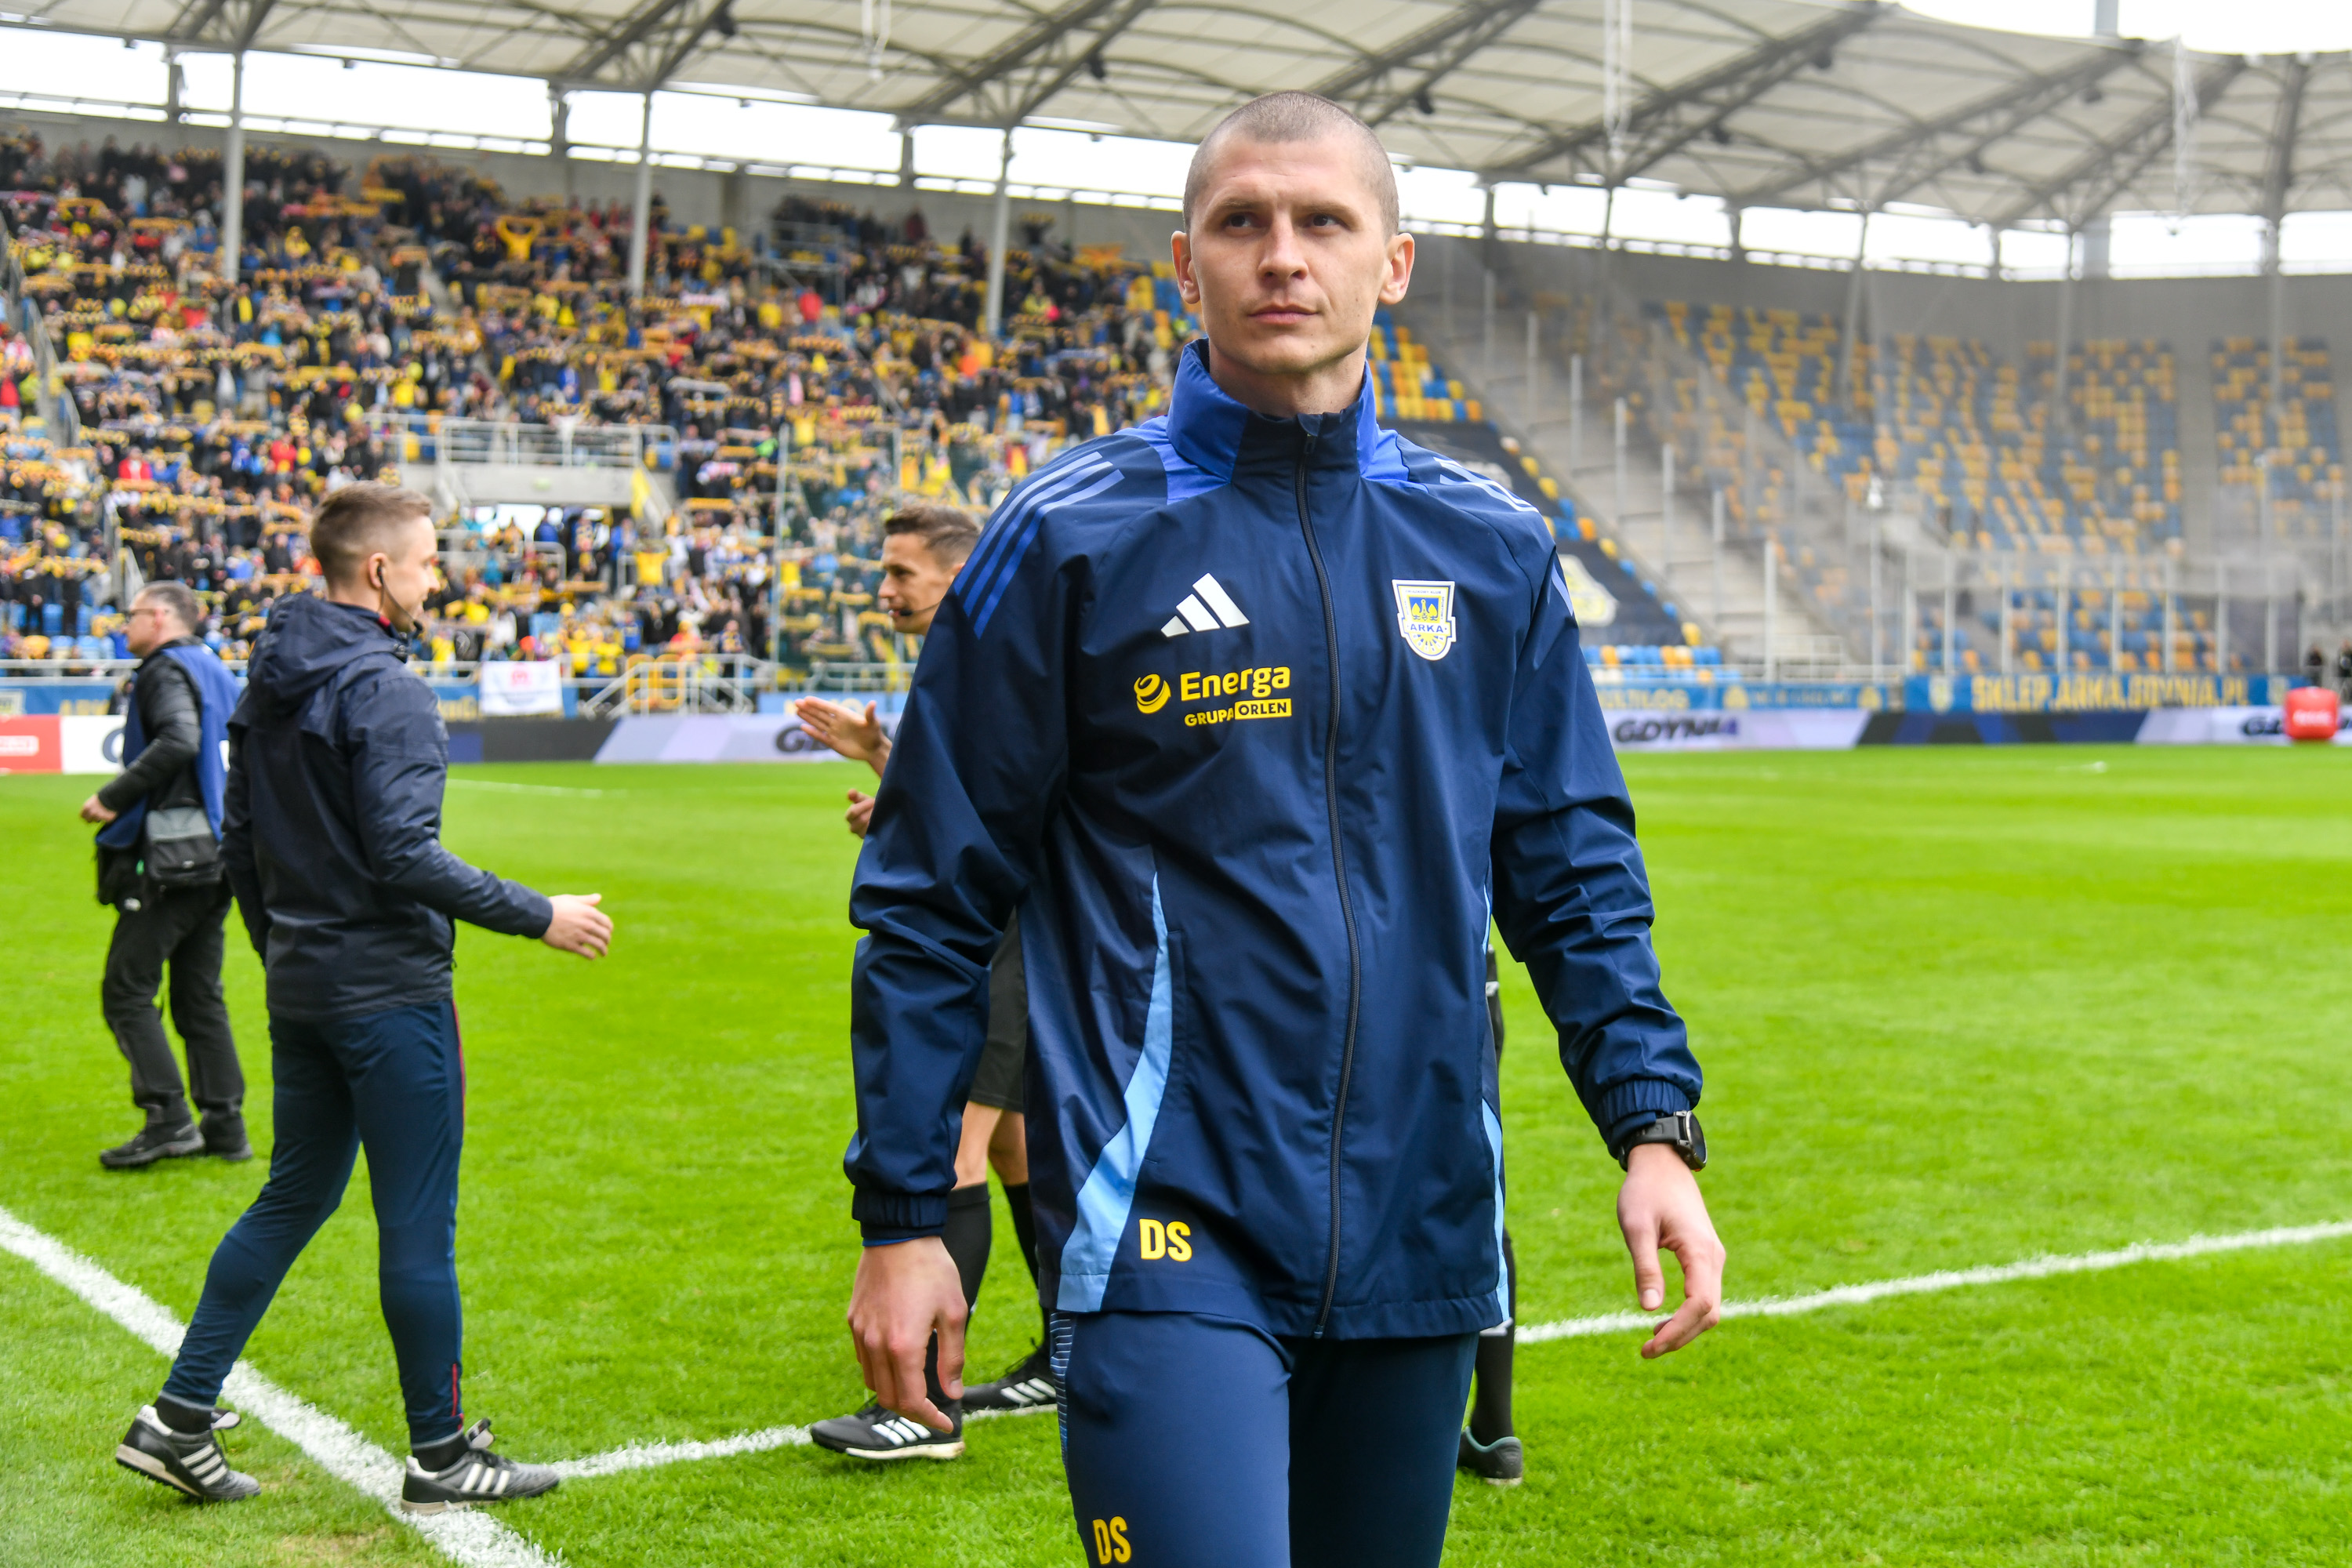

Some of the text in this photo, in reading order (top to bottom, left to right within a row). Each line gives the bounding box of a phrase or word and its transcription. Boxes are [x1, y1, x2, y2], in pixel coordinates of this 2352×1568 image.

[1410, 623, 1443, 633] ARKA
[1180, 666, 1291, 702] Energa
[1184, 702, 1287, 727] GRUPA ORLEN
[1139, 1218, 1192, 1262] DS
[1092, 1515, 1131, 1565] DS
